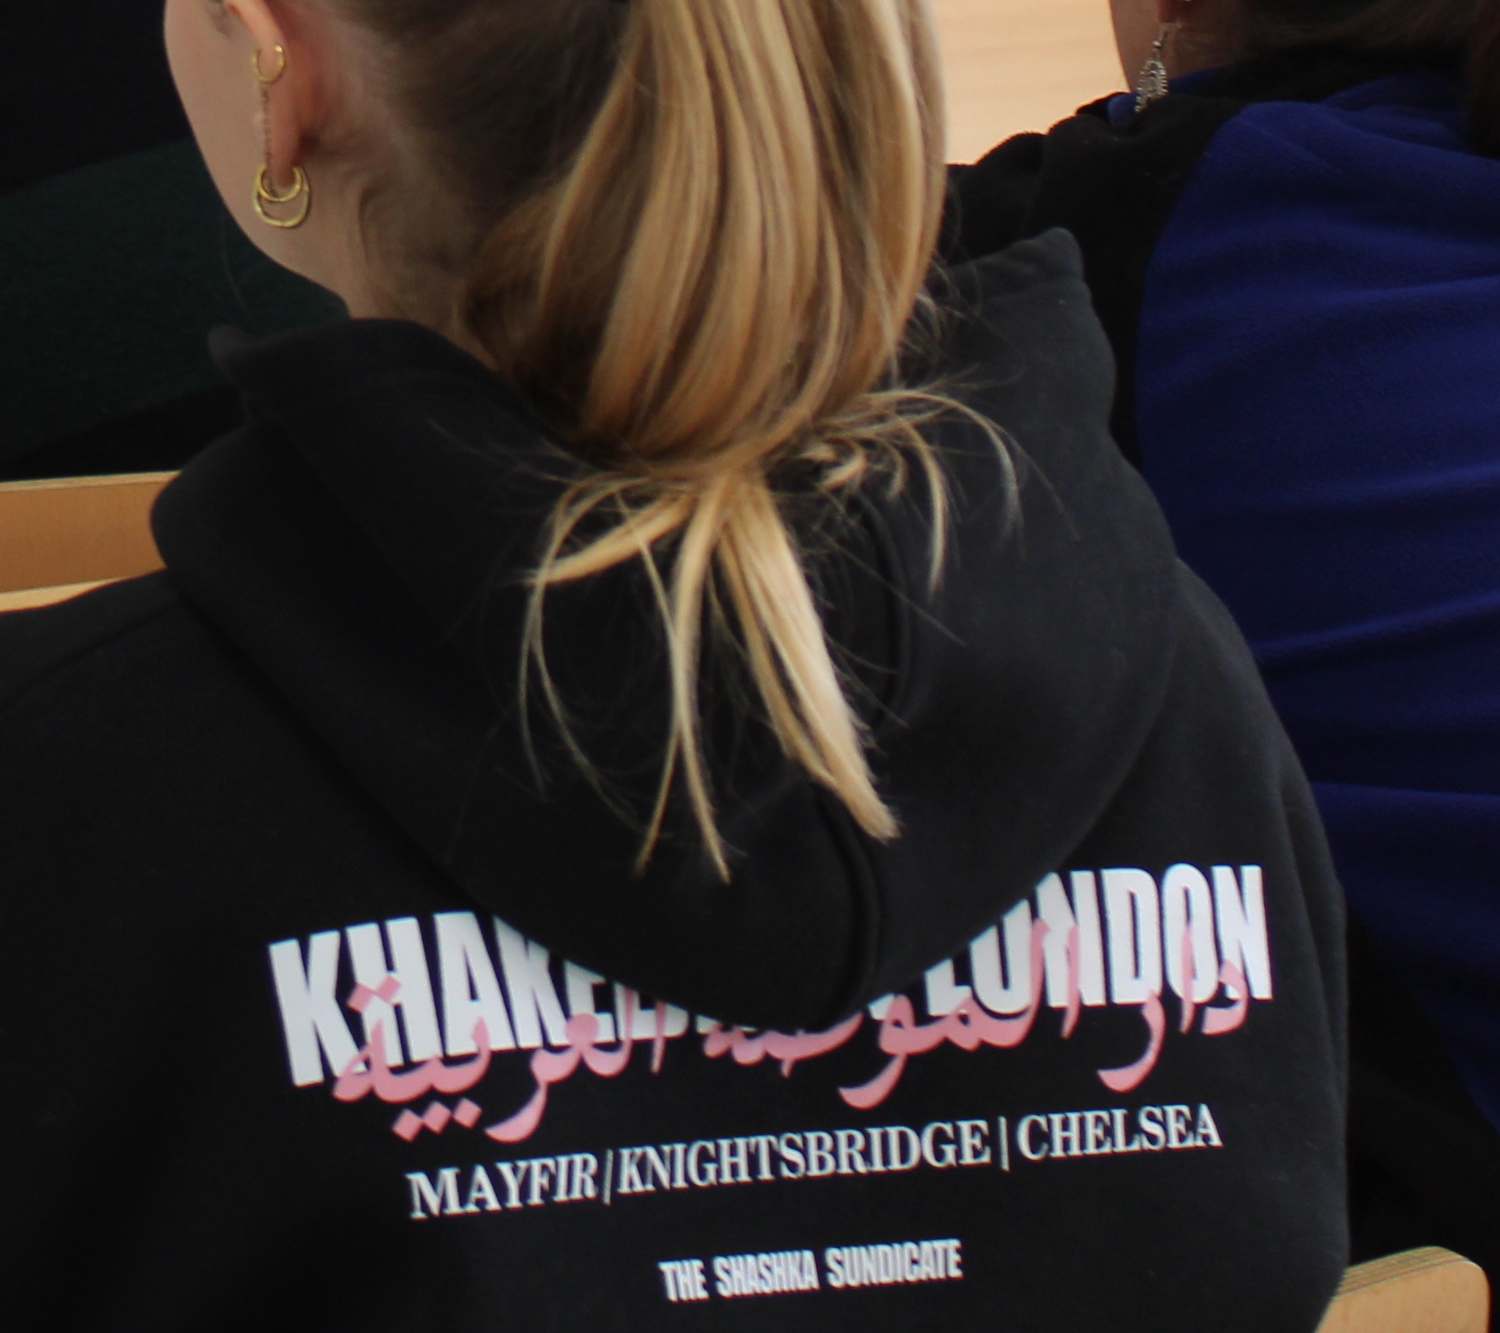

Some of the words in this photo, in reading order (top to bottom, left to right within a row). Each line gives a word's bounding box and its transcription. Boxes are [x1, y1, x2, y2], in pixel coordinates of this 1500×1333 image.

[659, 1259, 710, 1302] THE
[714, 1250, 820, 1299] SHASHKA
[826, 1238, 964, 1288] SUNDICATE
